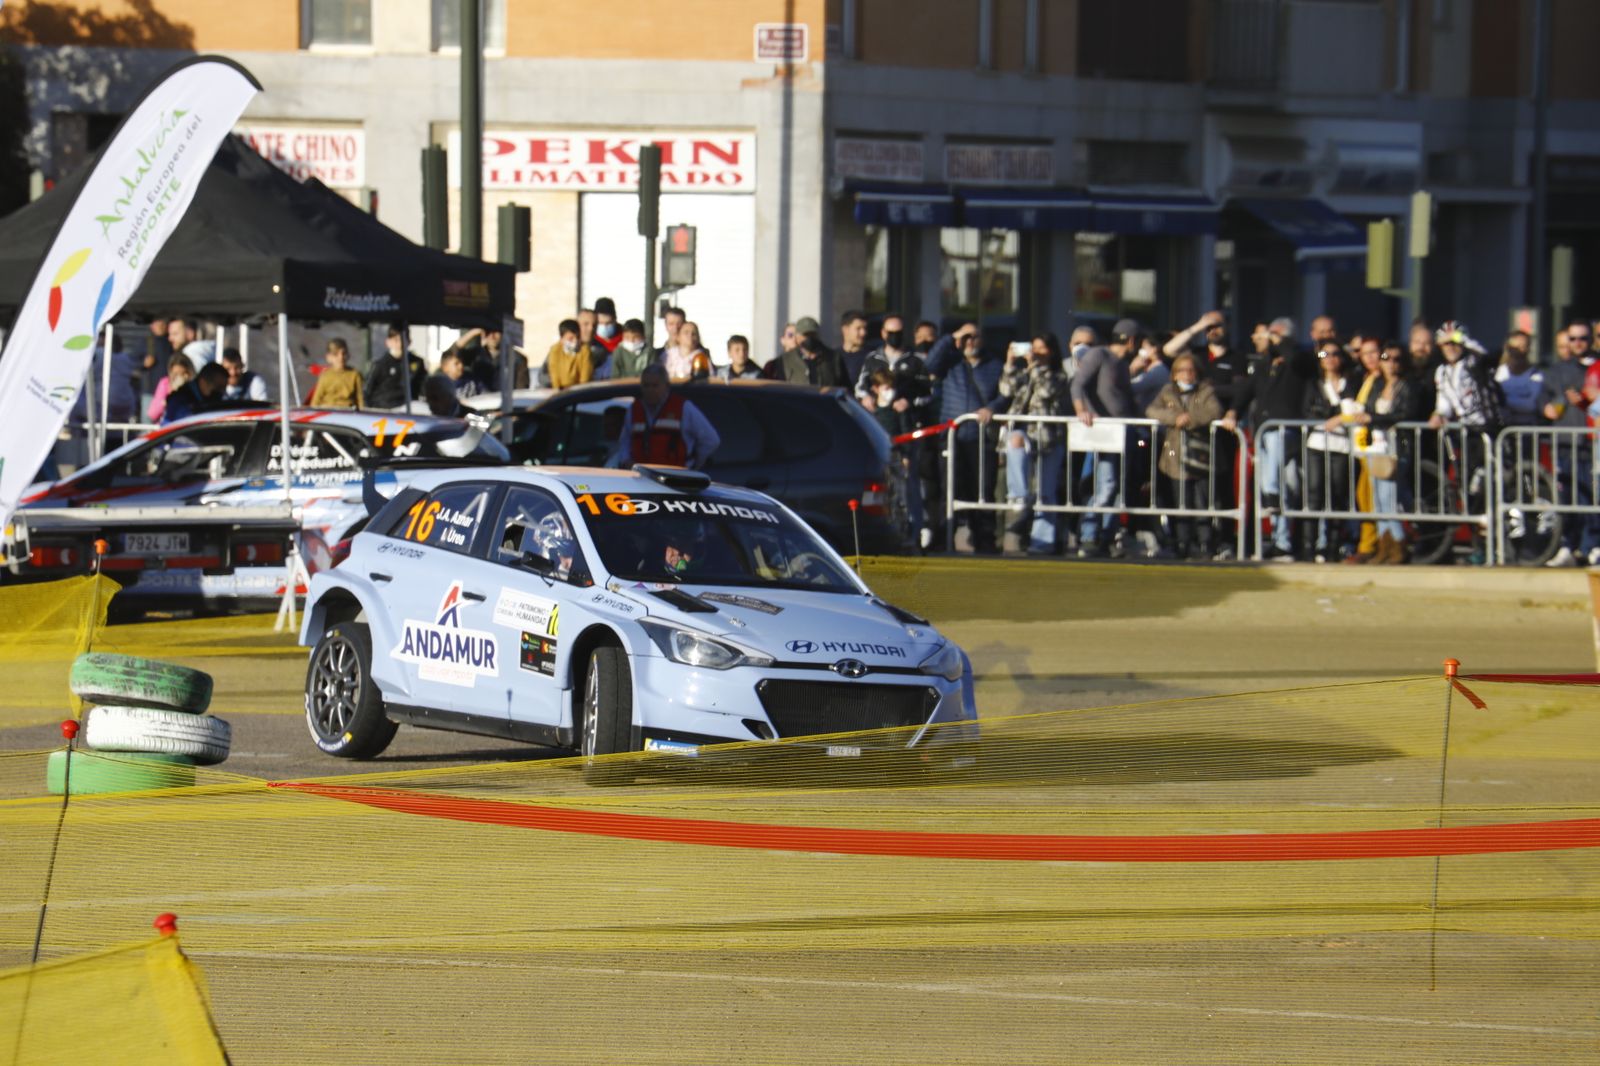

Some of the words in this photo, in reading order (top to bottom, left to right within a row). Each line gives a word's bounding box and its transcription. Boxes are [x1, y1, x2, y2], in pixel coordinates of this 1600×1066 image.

[146, 142, 186, 204] Europea
[186, 113, 203, 140] del
[292, 134, 356, 162] CHINO
[489, 169, 743, 186] LIMATIADO
[128, 175, 182, 269] DEPORTE
[372, 417, 416, 449] 17
[575, 493, 638, 516] 16
[662, 499, 780, 524] HYUNDAI
[404, 499, 441, 543] 16
[128, 536, 160, 551] 7924
[604, 597, 635, 614] HYUNDAI
[400, 625, 496, 670] ANDAMUR
[822, 641, 907, 658] HYUNDAI
